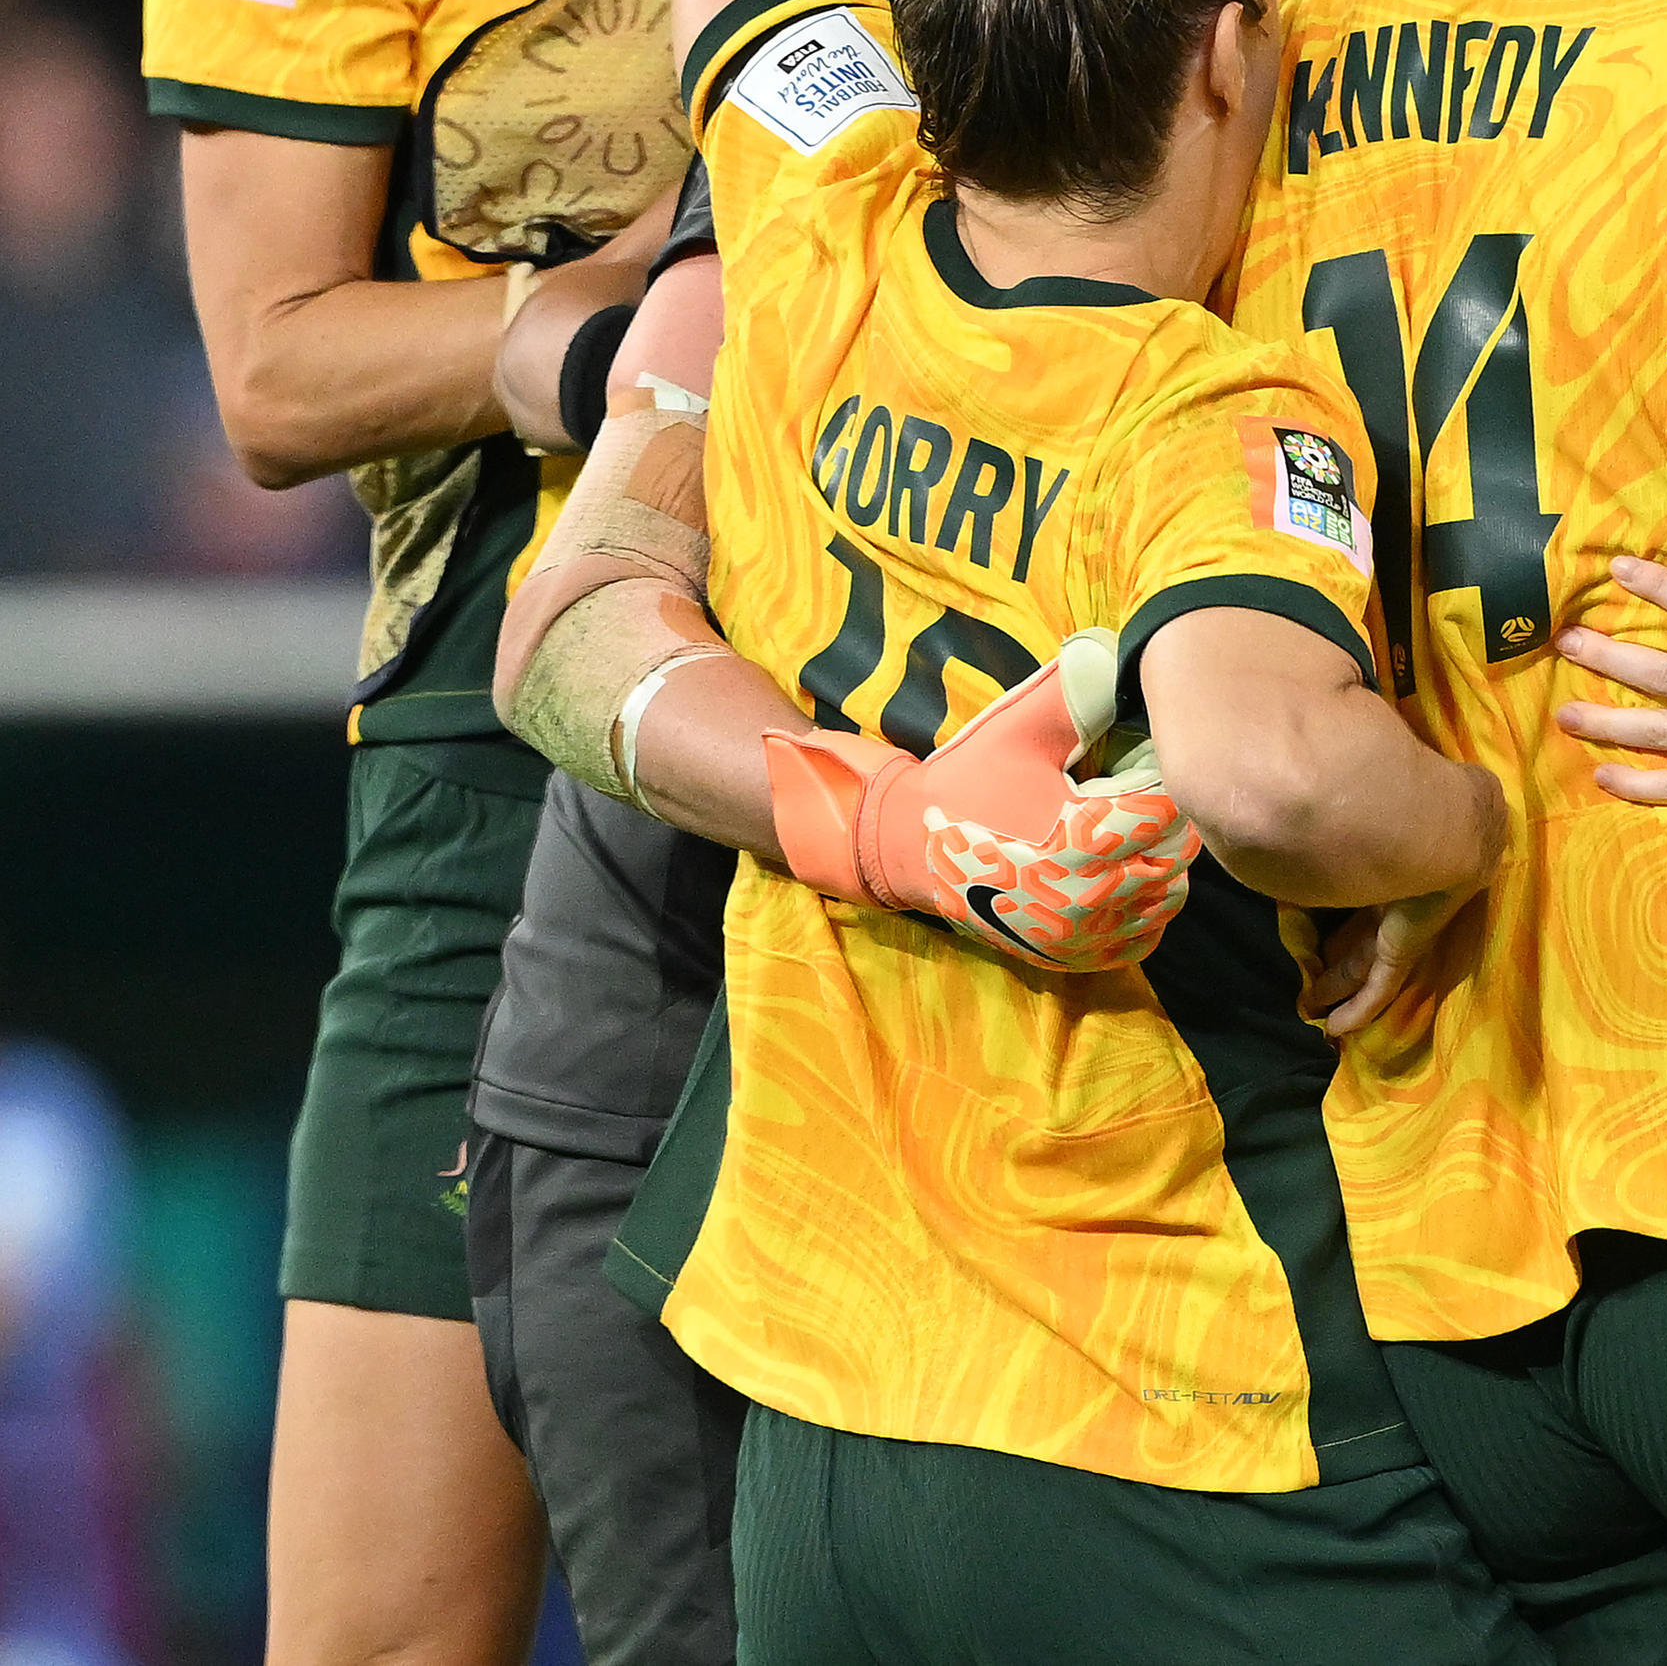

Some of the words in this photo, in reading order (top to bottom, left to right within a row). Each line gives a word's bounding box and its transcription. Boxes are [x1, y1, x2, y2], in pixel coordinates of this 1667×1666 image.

[827, 44, 862, 61] the
[777, 56, 831, 104] World
[795, 61, 876, 112] UNITES
[810, 80, 889, 119] FOOTBALL
[811, 394, 1071, 583] GORRY
[1301, 234, 1563, 699] 14
[1292, 500, 1322, 517] AU
